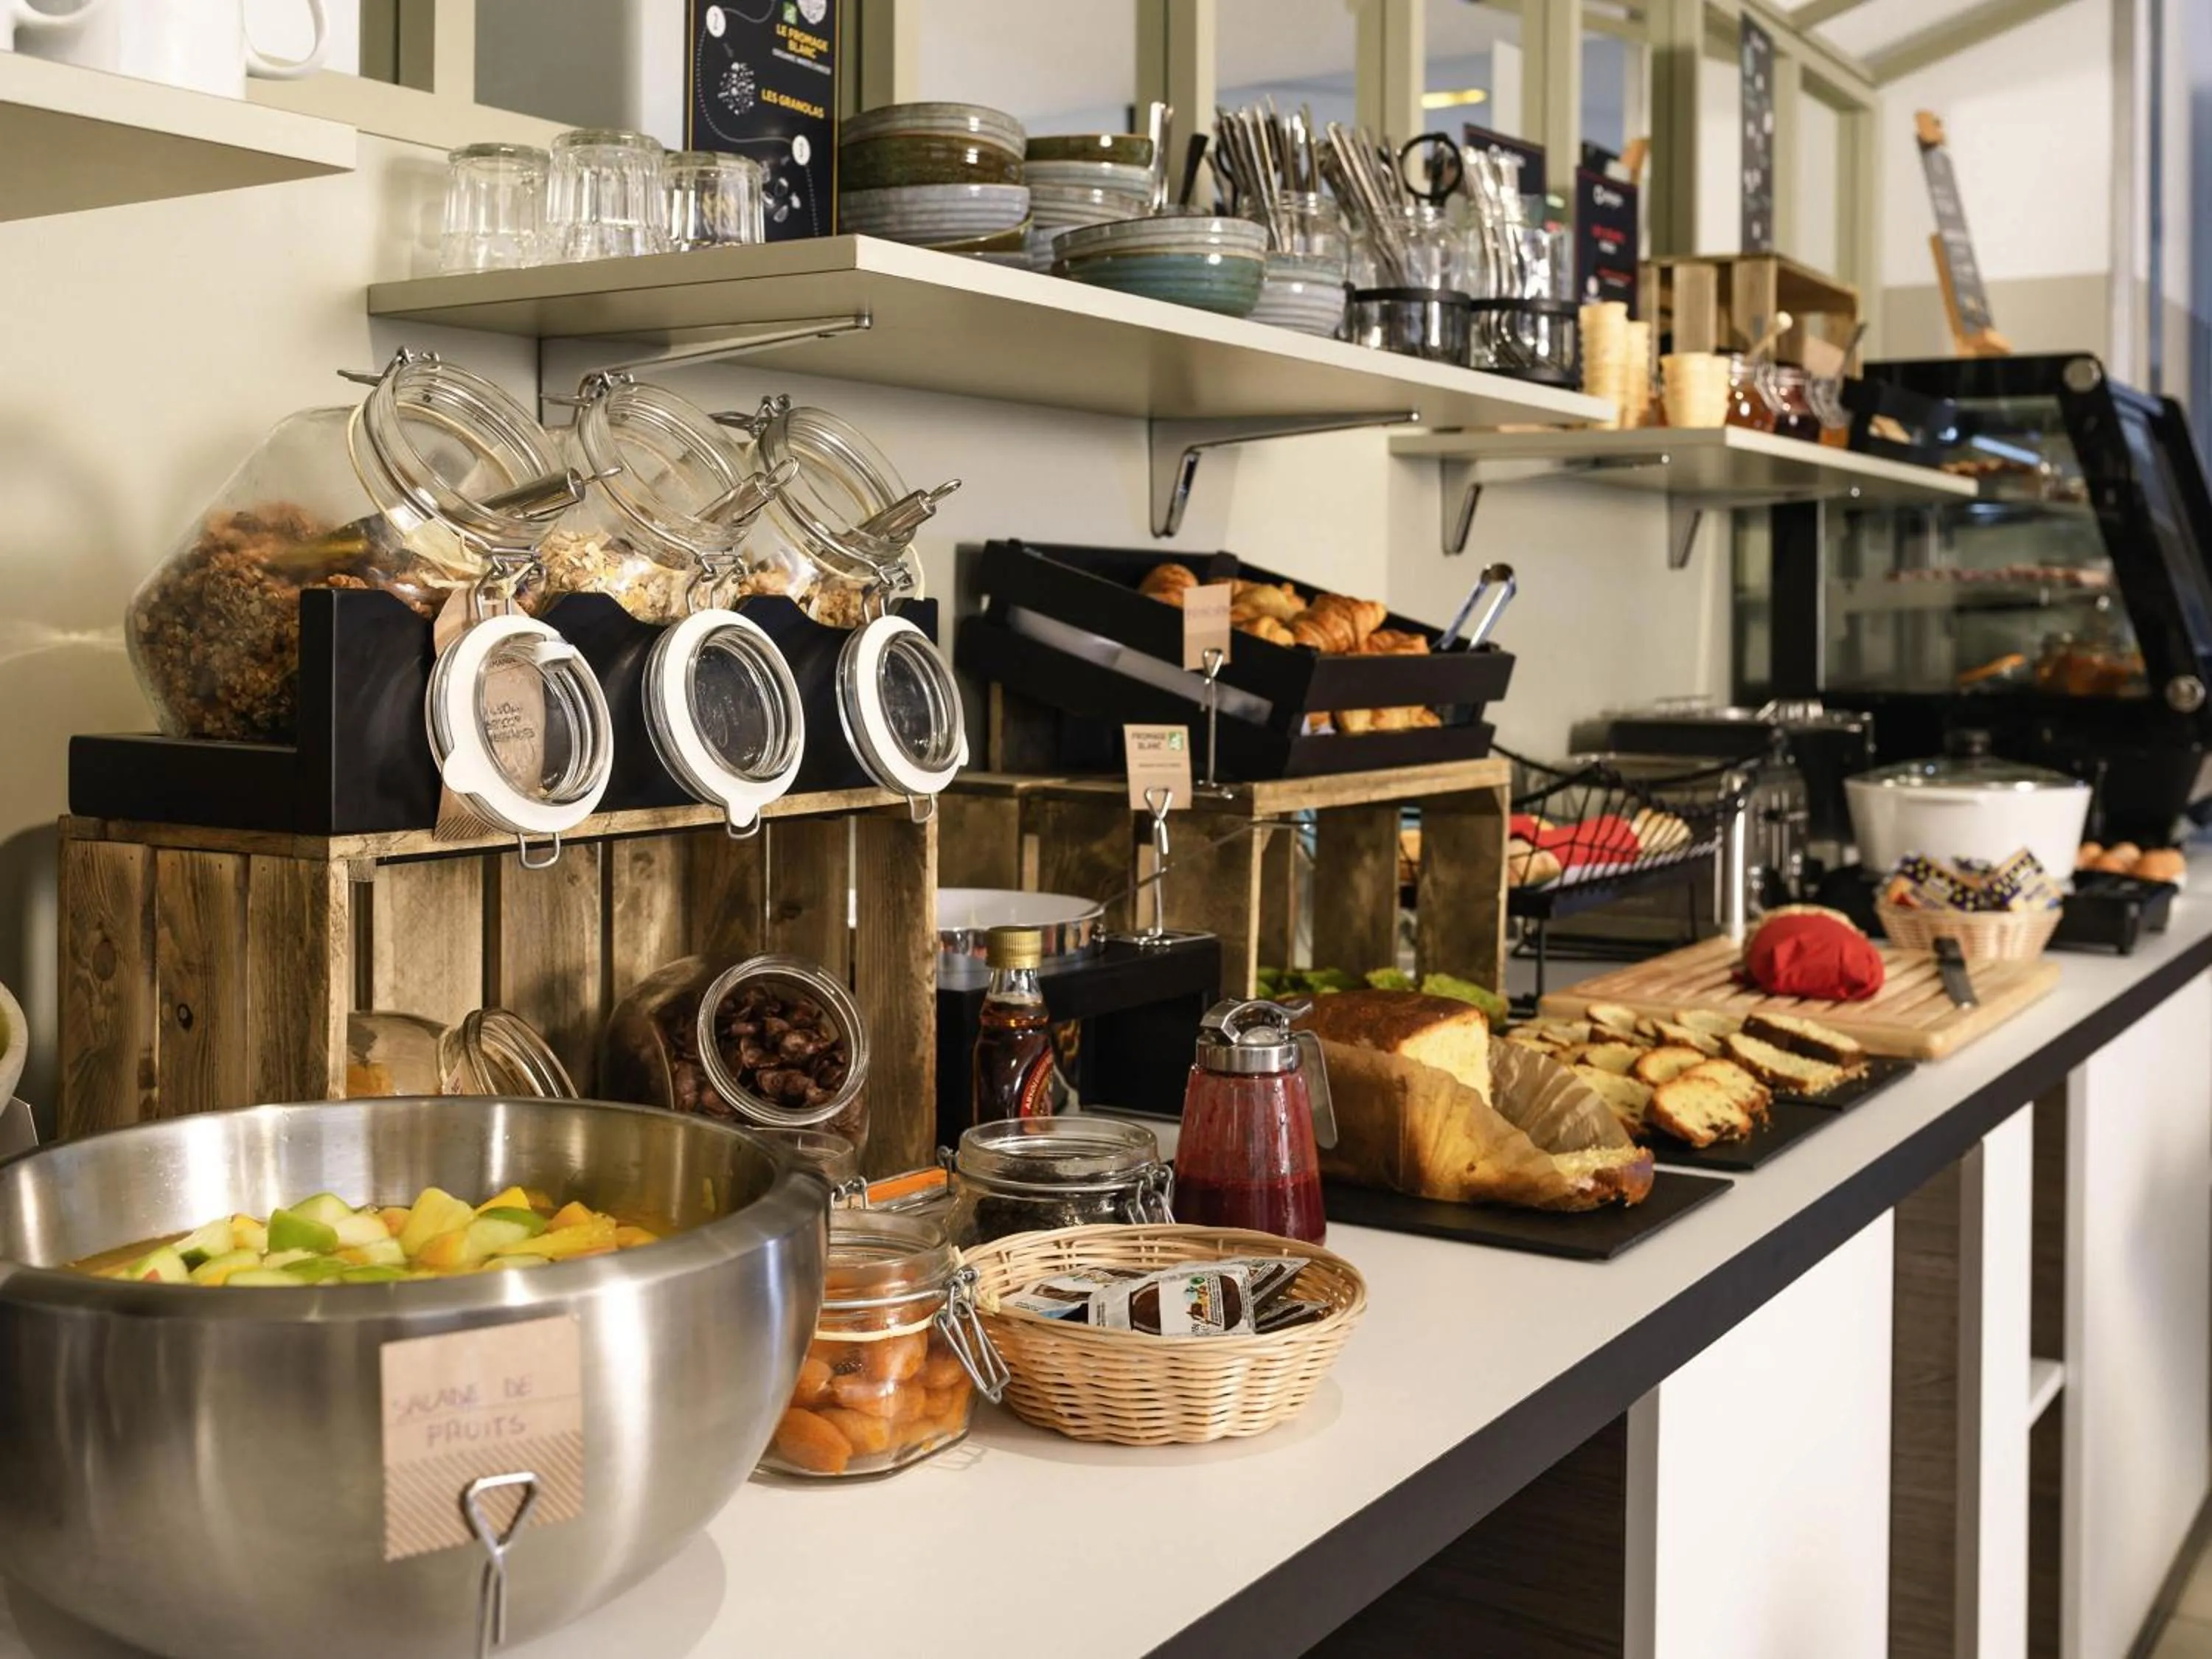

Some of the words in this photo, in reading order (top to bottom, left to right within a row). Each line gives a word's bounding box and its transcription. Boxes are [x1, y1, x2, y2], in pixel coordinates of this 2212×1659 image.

[776, 23, 787, 38] LE
[761, 88, 778, 104] LES
[778, 94, 824, 118] GRANOLAS
[503, 1373, 534, 1398] DE
[425, 1414, 527, 1448] FRUITS
